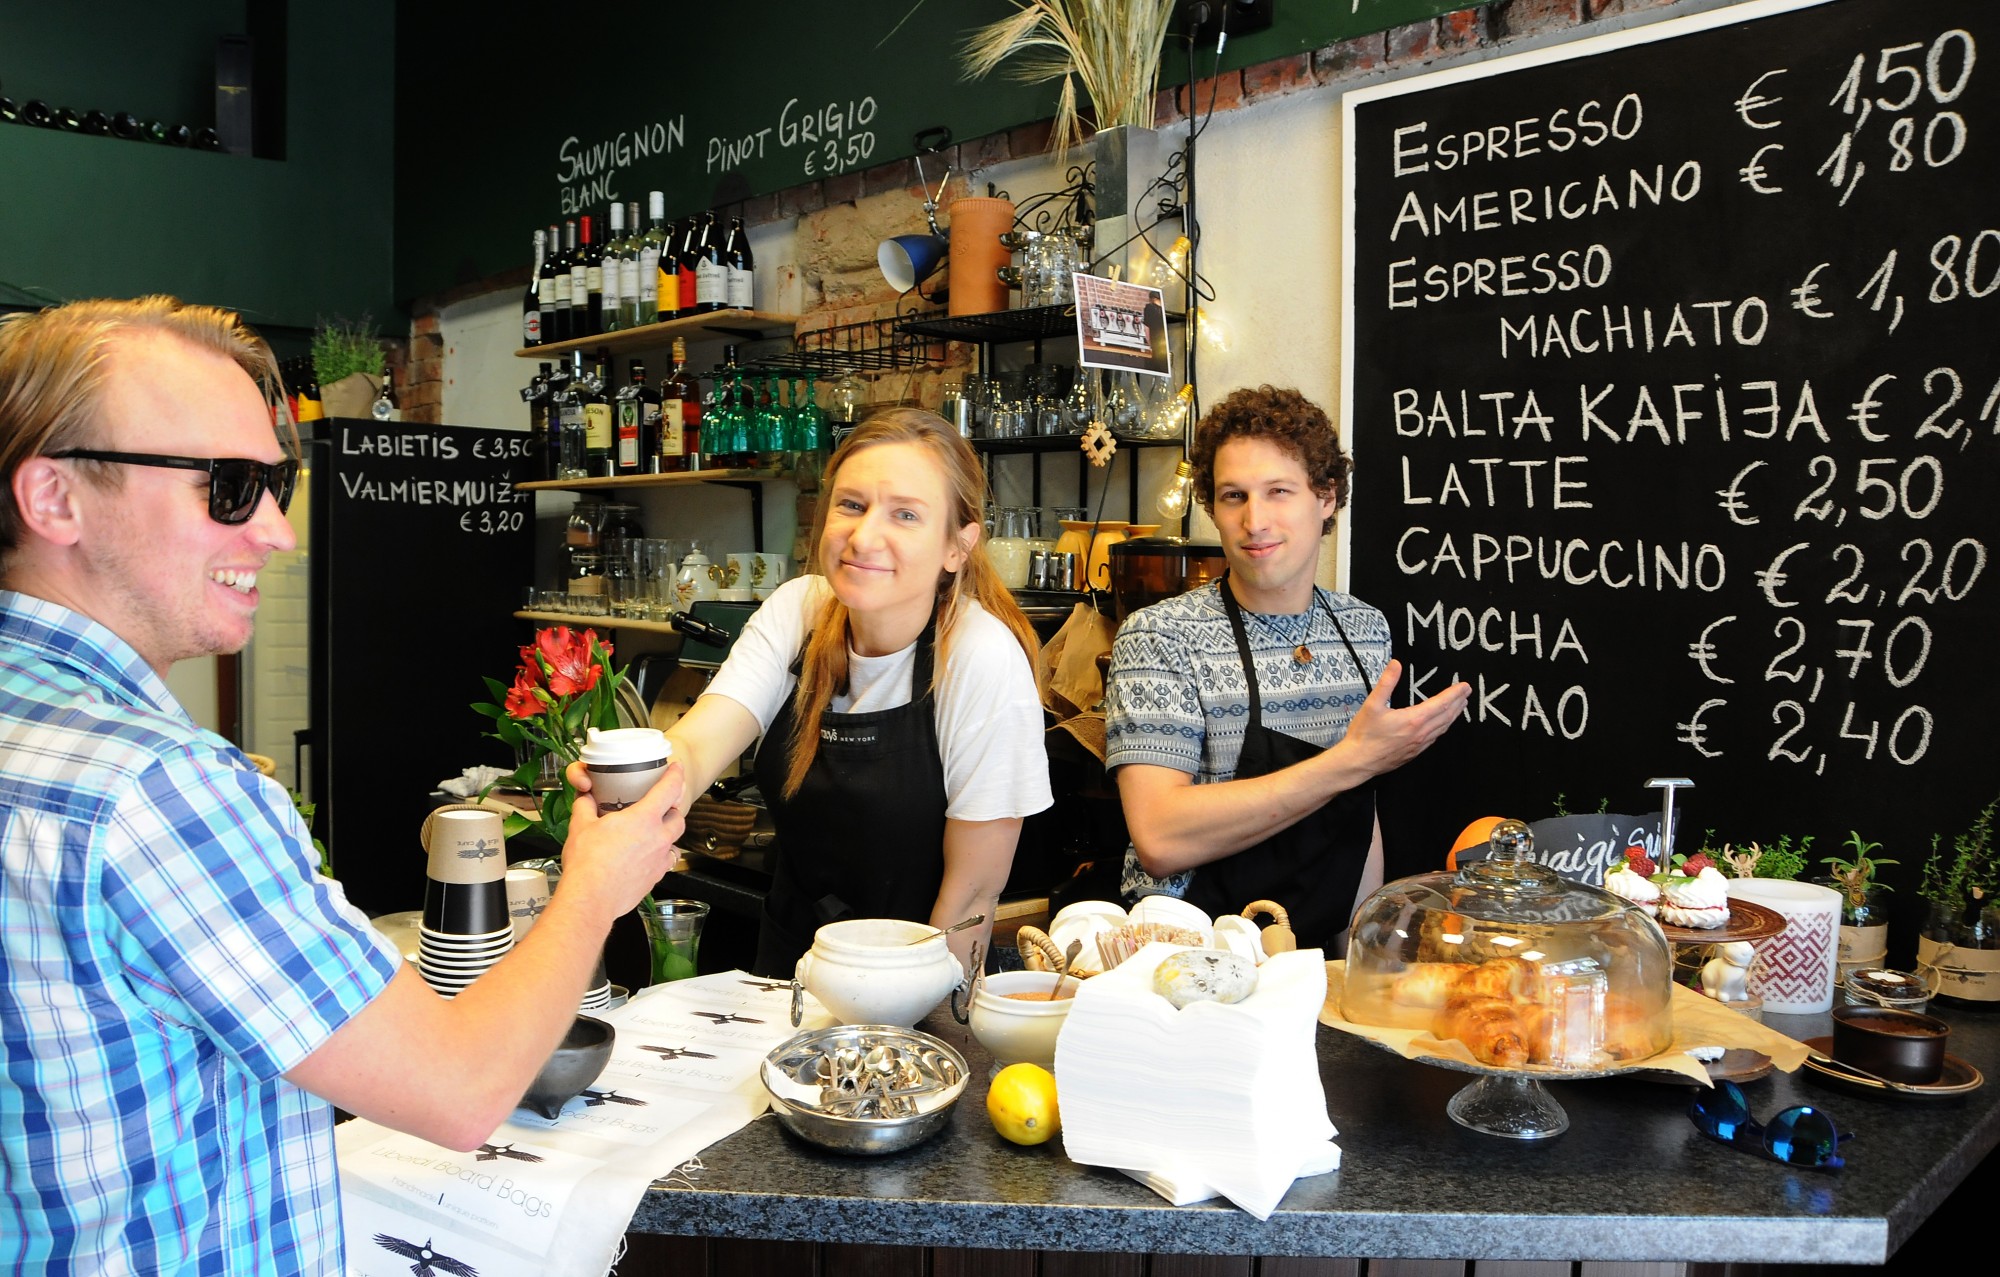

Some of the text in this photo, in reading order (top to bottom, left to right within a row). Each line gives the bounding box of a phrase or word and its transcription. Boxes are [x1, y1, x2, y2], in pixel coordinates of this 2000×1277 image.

[779, 97, 877, 146] GRIGIO
[1394, 29, 1975, 176] ESPRESSO € 1,50
[557, 114, 684, 182] SAUVIGNON
[804, 132, 875, 176] € 3,50
[1390, 112, 1967, 241] AMERICANO € 1,80
[561, 170, 618, 215] BLANC
[1388, 245, 1611, 310] ESPRESSO
[1501, 229, 2000, 359] MACHIATO € 1,80
[1393, 388, 1554, 443] BALTA
[1848, 374, 1897, 443] €
[472, 438, 486, 458] €
[460, 511, 523, 534] € 3,20
[1402, 455, 1943, 527] LATTE € 2,50
[1396, 526, 1987, 607] CAPPUCCINO € 2,20
[1406, 601, 1932, 703] MOCHA € 2,70
[1676, 699, 1727, 757] €
[1768, 701, 1933, 776] 2,40
[561, 1108, 606, 1123] oard
[609, 1119, 658, 1134] Bags
[372, 1148, 552, 1218] Liberal Board Bags
[392, 1176, 438, 1202] handmade
